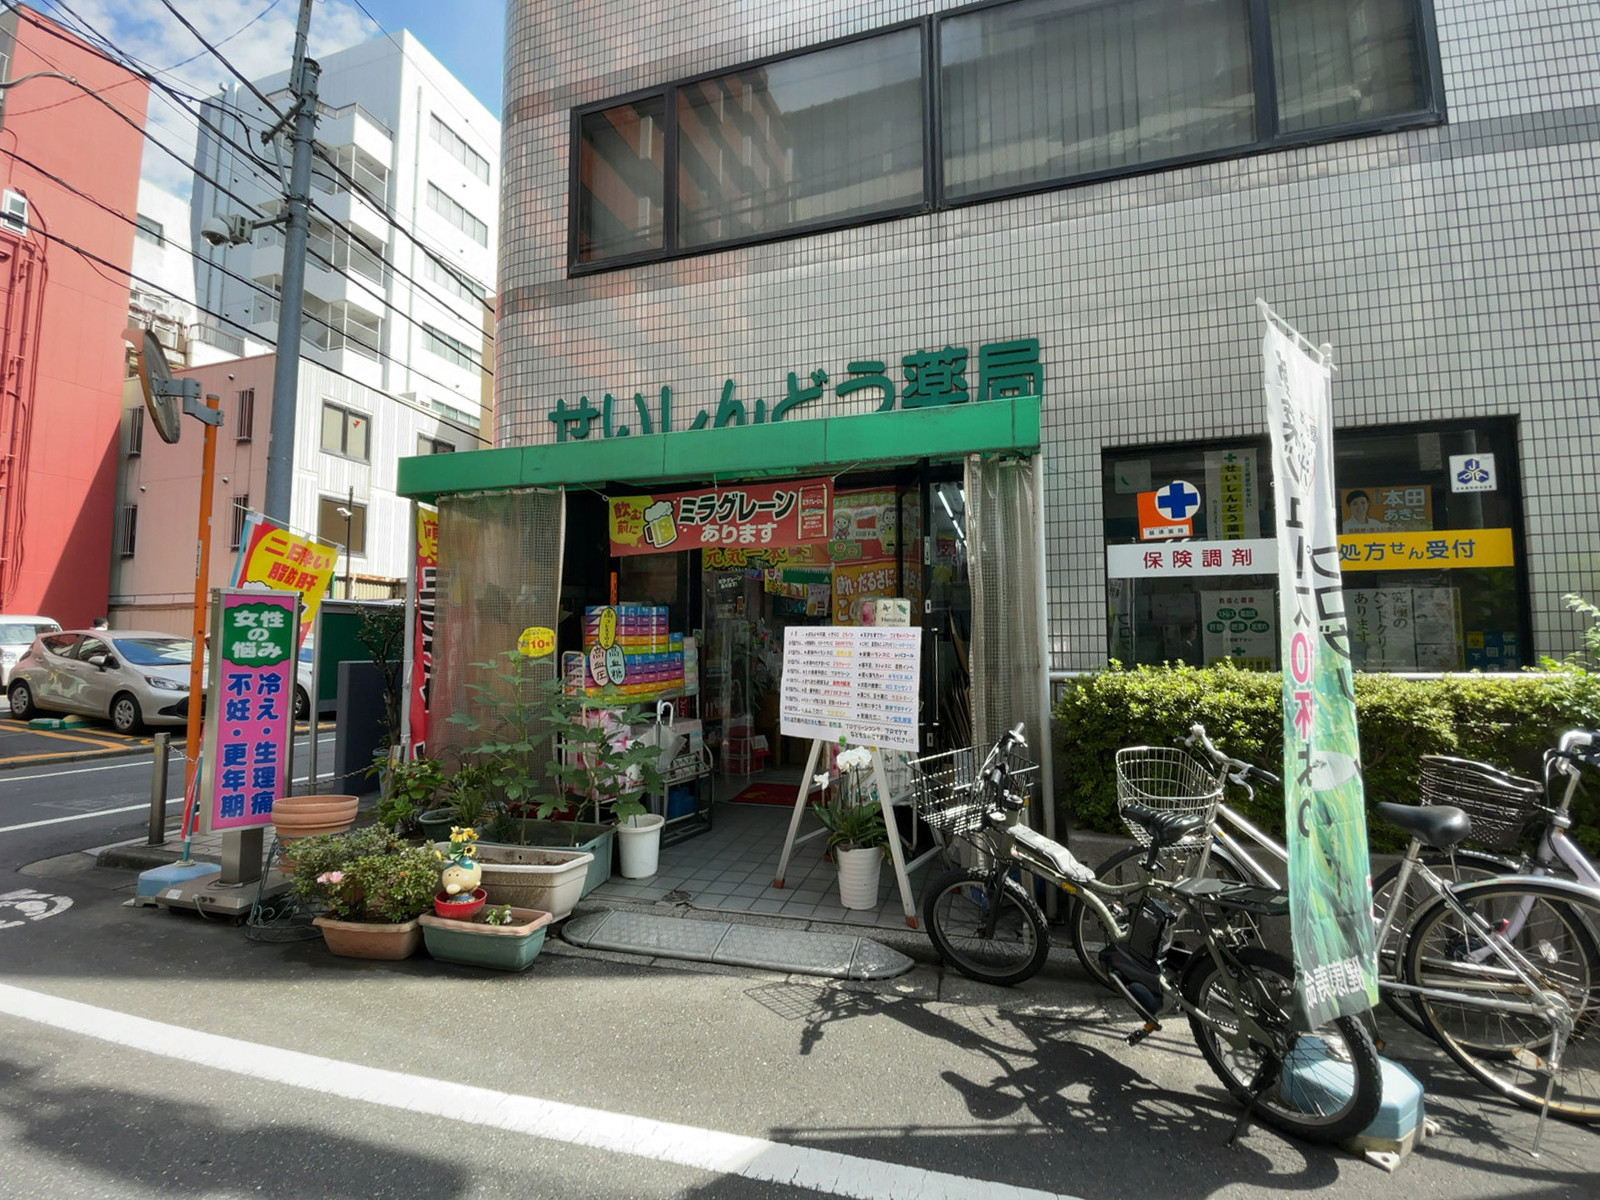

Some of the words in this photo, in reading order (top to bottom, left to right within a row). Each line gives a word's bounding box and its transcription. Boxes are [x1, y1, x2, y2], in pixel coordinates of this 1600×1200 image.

[549, 338, 1043, 443] せいしんどう薬局
[678, 489, 797, 526] ミラグレーン
[1382, 488, 1425, 507] 本田
[613, 502, 642, 521] 飲む
[1384, 508, 1426, 521] あきこ
[617, 520, 640, 536] 前に
[700, 521, 778, 545] あります
[265, 536, 330, 570] 二日酔い
[704, 547, 785, 568] 元気一本
[1142, 548, 1254, 570] 保険調剤
[1338, 538, 1475, 561] 処方せん受付
[267, 561, 320, 592] 脂肪肝
[232, 610, 284, 629] 女性
[1354, 591, 1370, 642] あります
[246, 627, 270, 641] の
[231, 641, 283, 660] 悩み
[220, 673, 255, 819] 不妊・更年期
[250, 672, 282, 815] 冷え・生理痛
